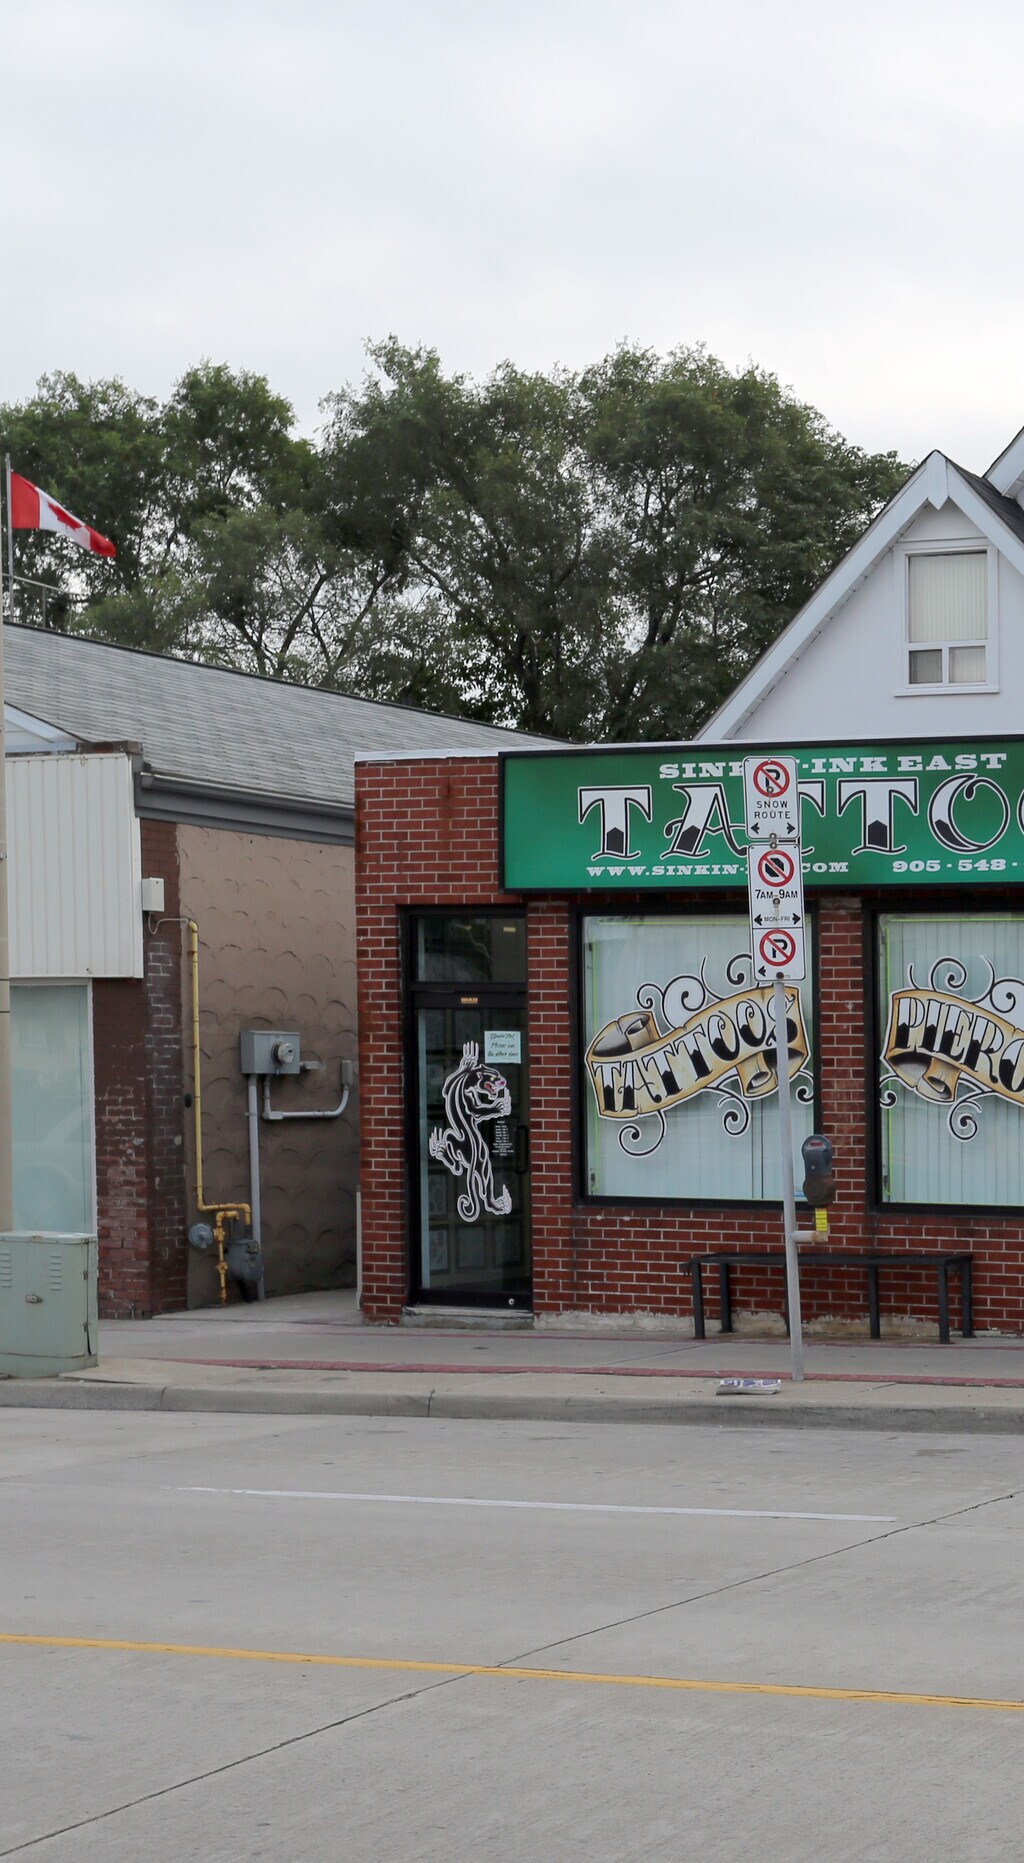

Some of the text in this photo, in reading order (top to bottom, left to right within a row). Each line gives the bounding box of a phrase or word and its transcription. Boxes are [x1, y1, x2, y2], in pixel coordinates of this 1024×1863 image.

[897, 753, 1007, 771] EAST
[757, 800, 788, 809] SNOW
[754, 811, 791, 819] ROUTE
[592, 992, 799, 1112] TATTOOS
